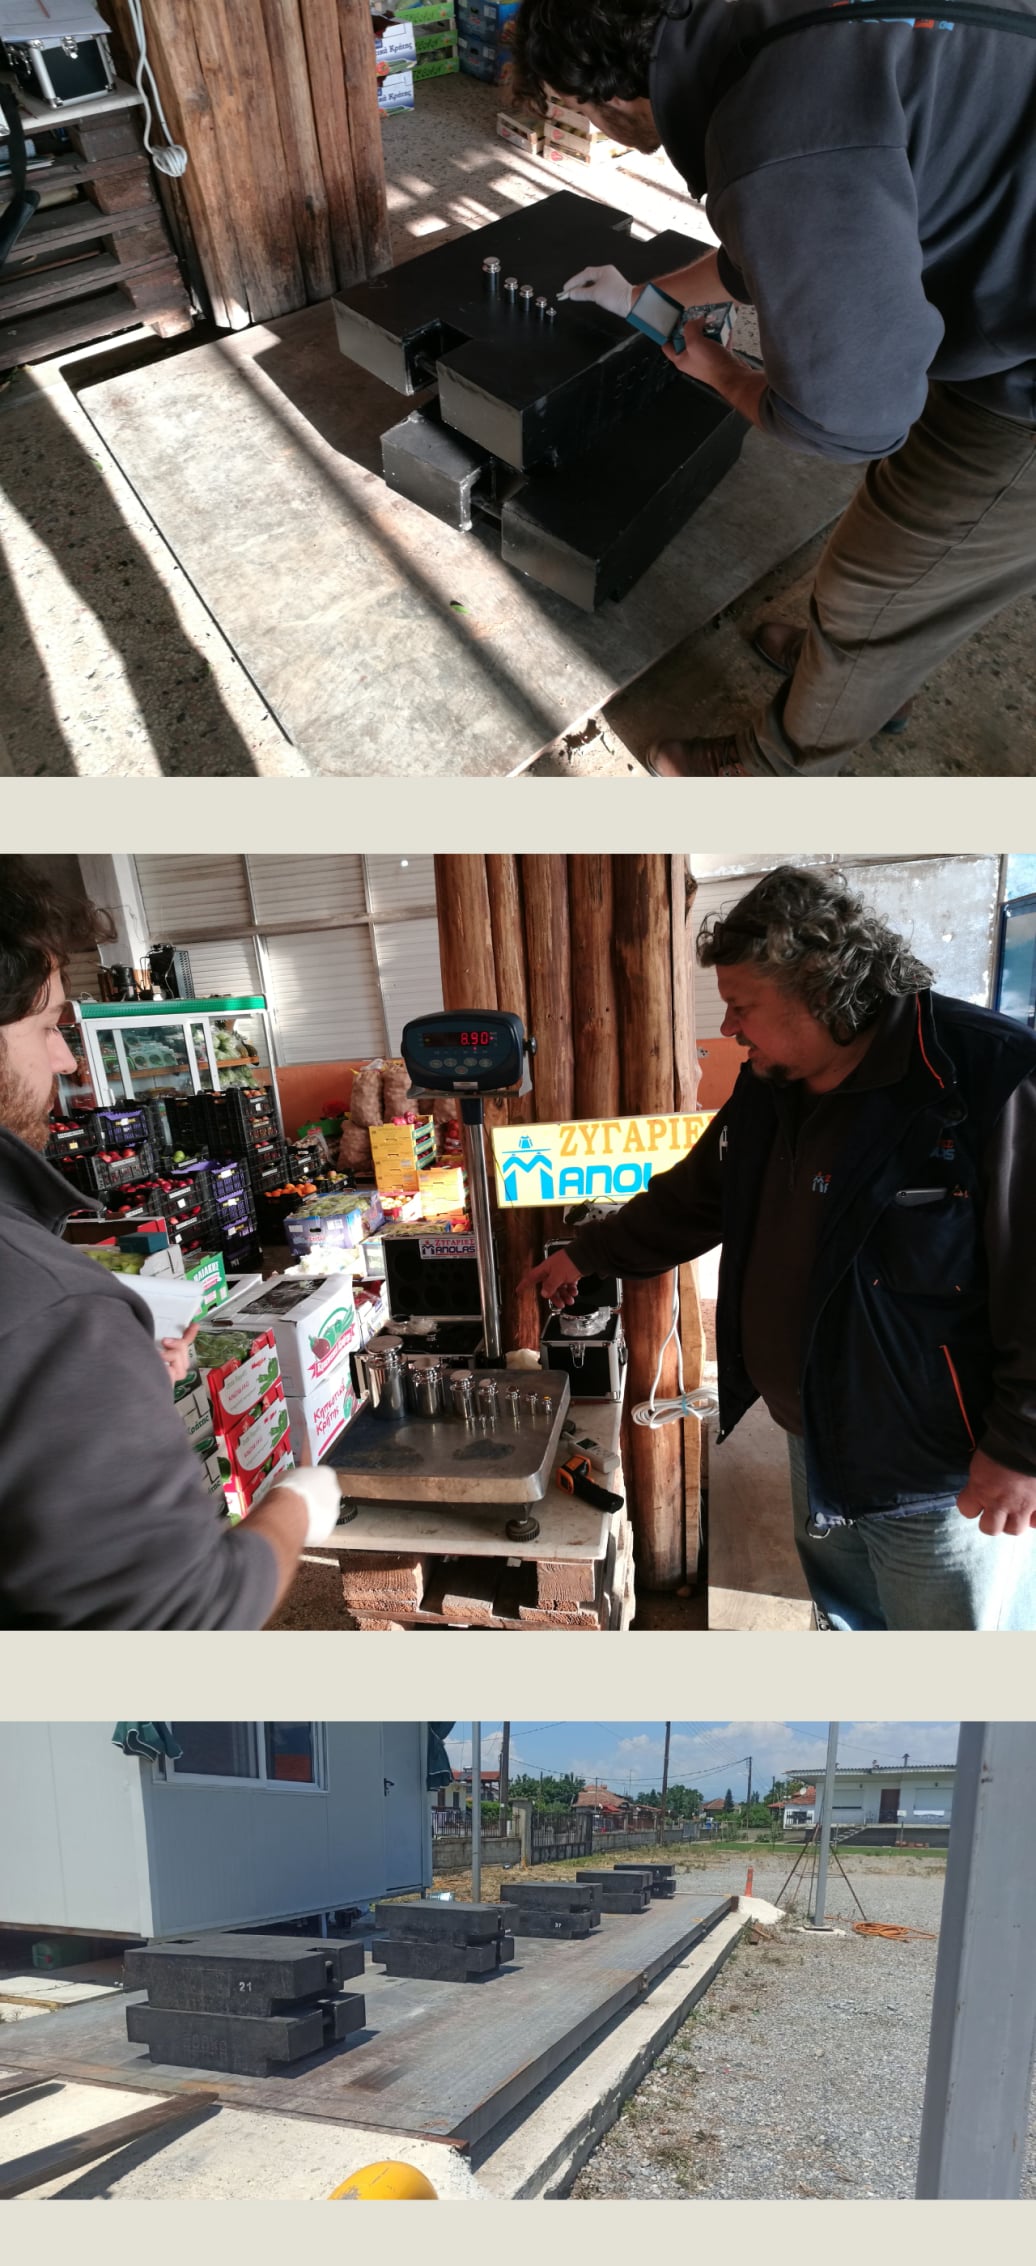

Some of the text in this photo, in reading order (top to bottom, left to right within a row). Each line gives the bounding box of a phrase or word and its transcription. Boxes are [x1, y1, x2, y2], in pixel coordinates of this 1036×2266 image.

[460, 1031, 489, 1046] 8.90
[559, 1115, 714, 1157] ΖΥΓΑΡΙΕ
[502, 1152, 653, 1201] MANOL
[421, 1244, 476, 1255] MANOLAS
[239, 1981, 252, 1992] 21
